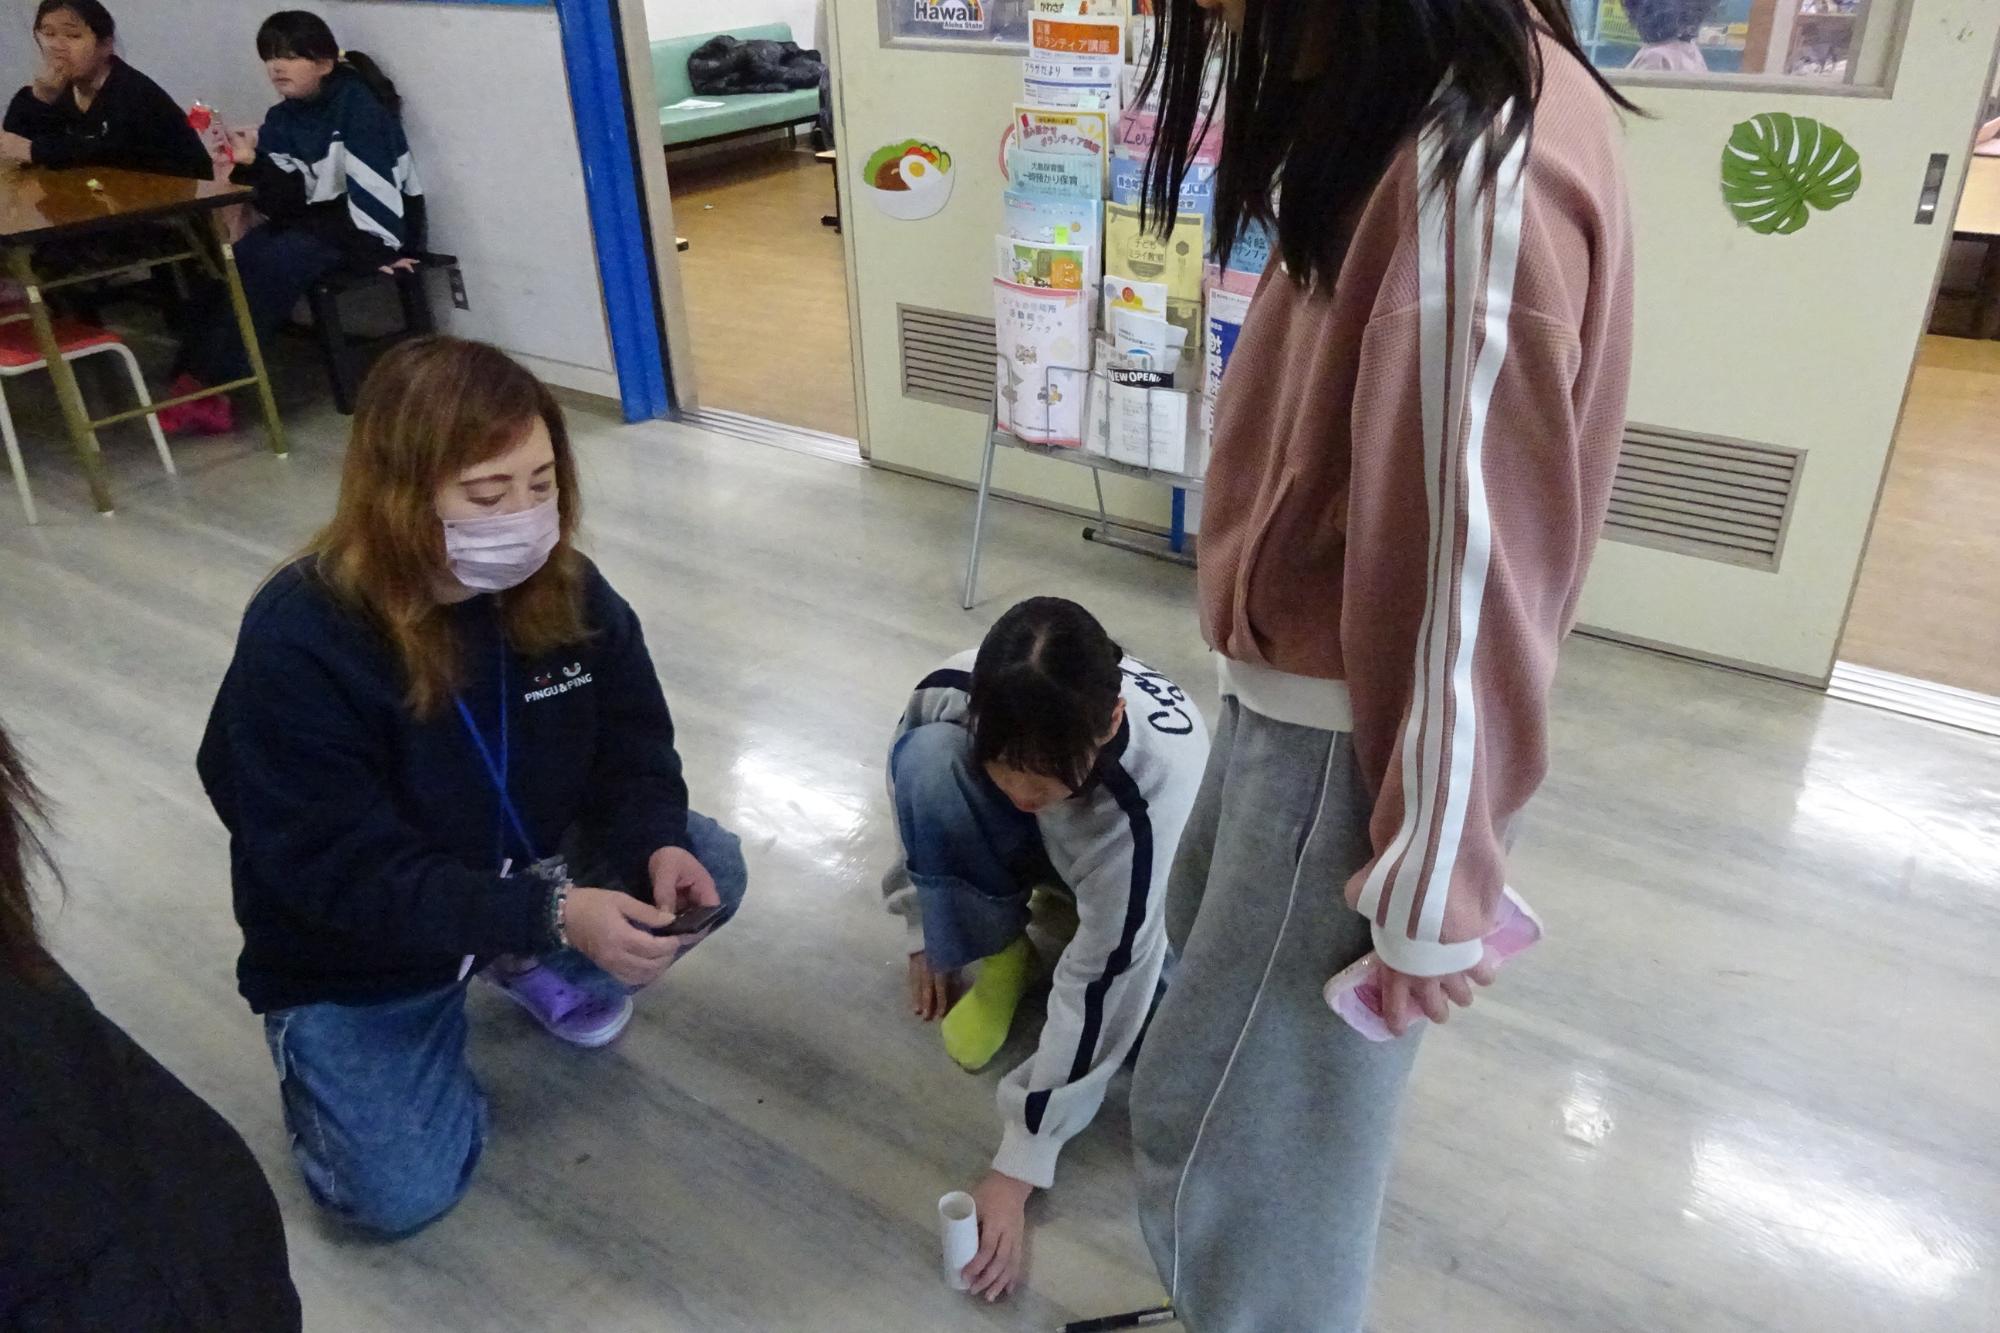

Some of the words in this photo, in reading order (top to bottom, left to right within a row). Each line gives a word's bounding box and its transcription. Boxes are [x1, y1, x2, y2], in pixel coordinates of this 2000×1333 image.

[915, 1, 979, 21] Hawaii
[944, 21, 963, 29] Aloha
[1035, 36, 1110, 53] ボランティア講座
[1022, 171, 1079, 186] 一時預かり保育
[1107, 370, 1128, 382] NEW
